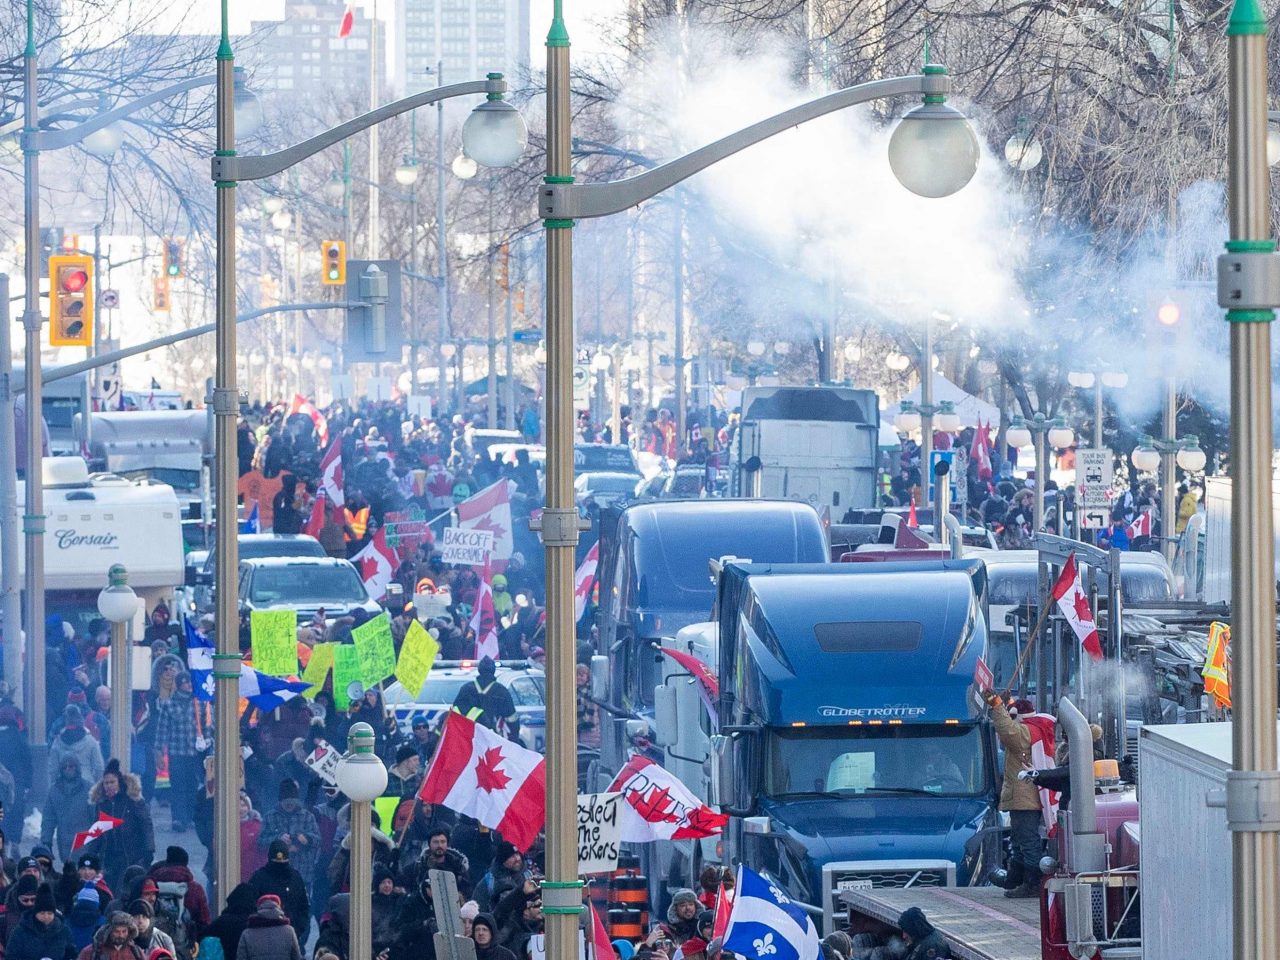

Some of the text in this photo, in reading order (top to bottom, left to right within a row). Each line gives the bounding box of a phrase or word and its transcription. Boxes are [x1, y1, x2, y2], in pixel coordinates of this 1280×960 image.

[54, 529, 118, 549] Corsair
[444, 529, 491, 547] BACK OFF
[820, 707, 926, 717] GLOBETROTTER
